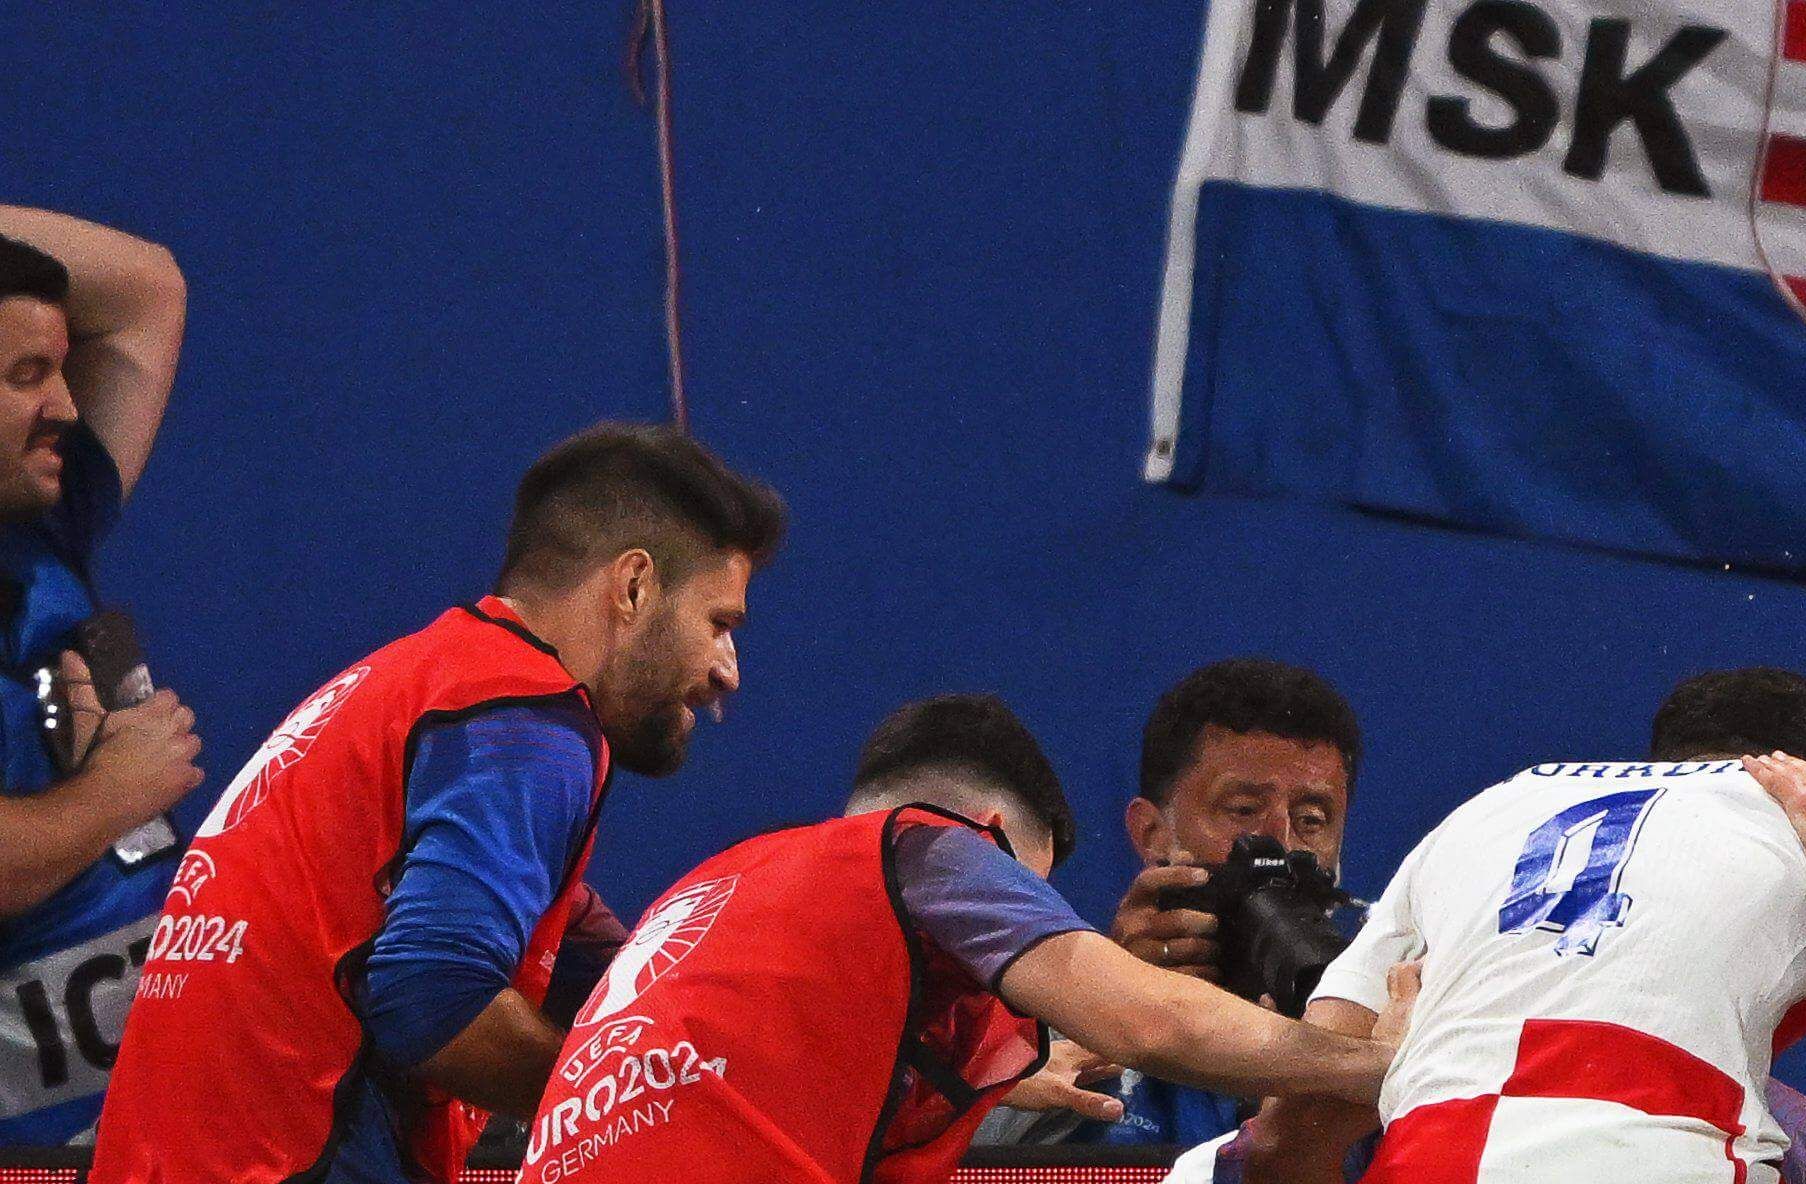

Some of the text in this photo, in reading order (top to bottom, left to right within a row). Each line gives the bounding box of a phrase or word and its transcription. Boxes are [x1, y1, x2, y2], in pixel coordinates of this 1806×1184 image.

[1233, 0, 1728, 198] MSK
[1498, 787, 1668, 957] 4
[146, 914, 248, 963] O2024
[563, 1025, 643, 1082] UEFA
